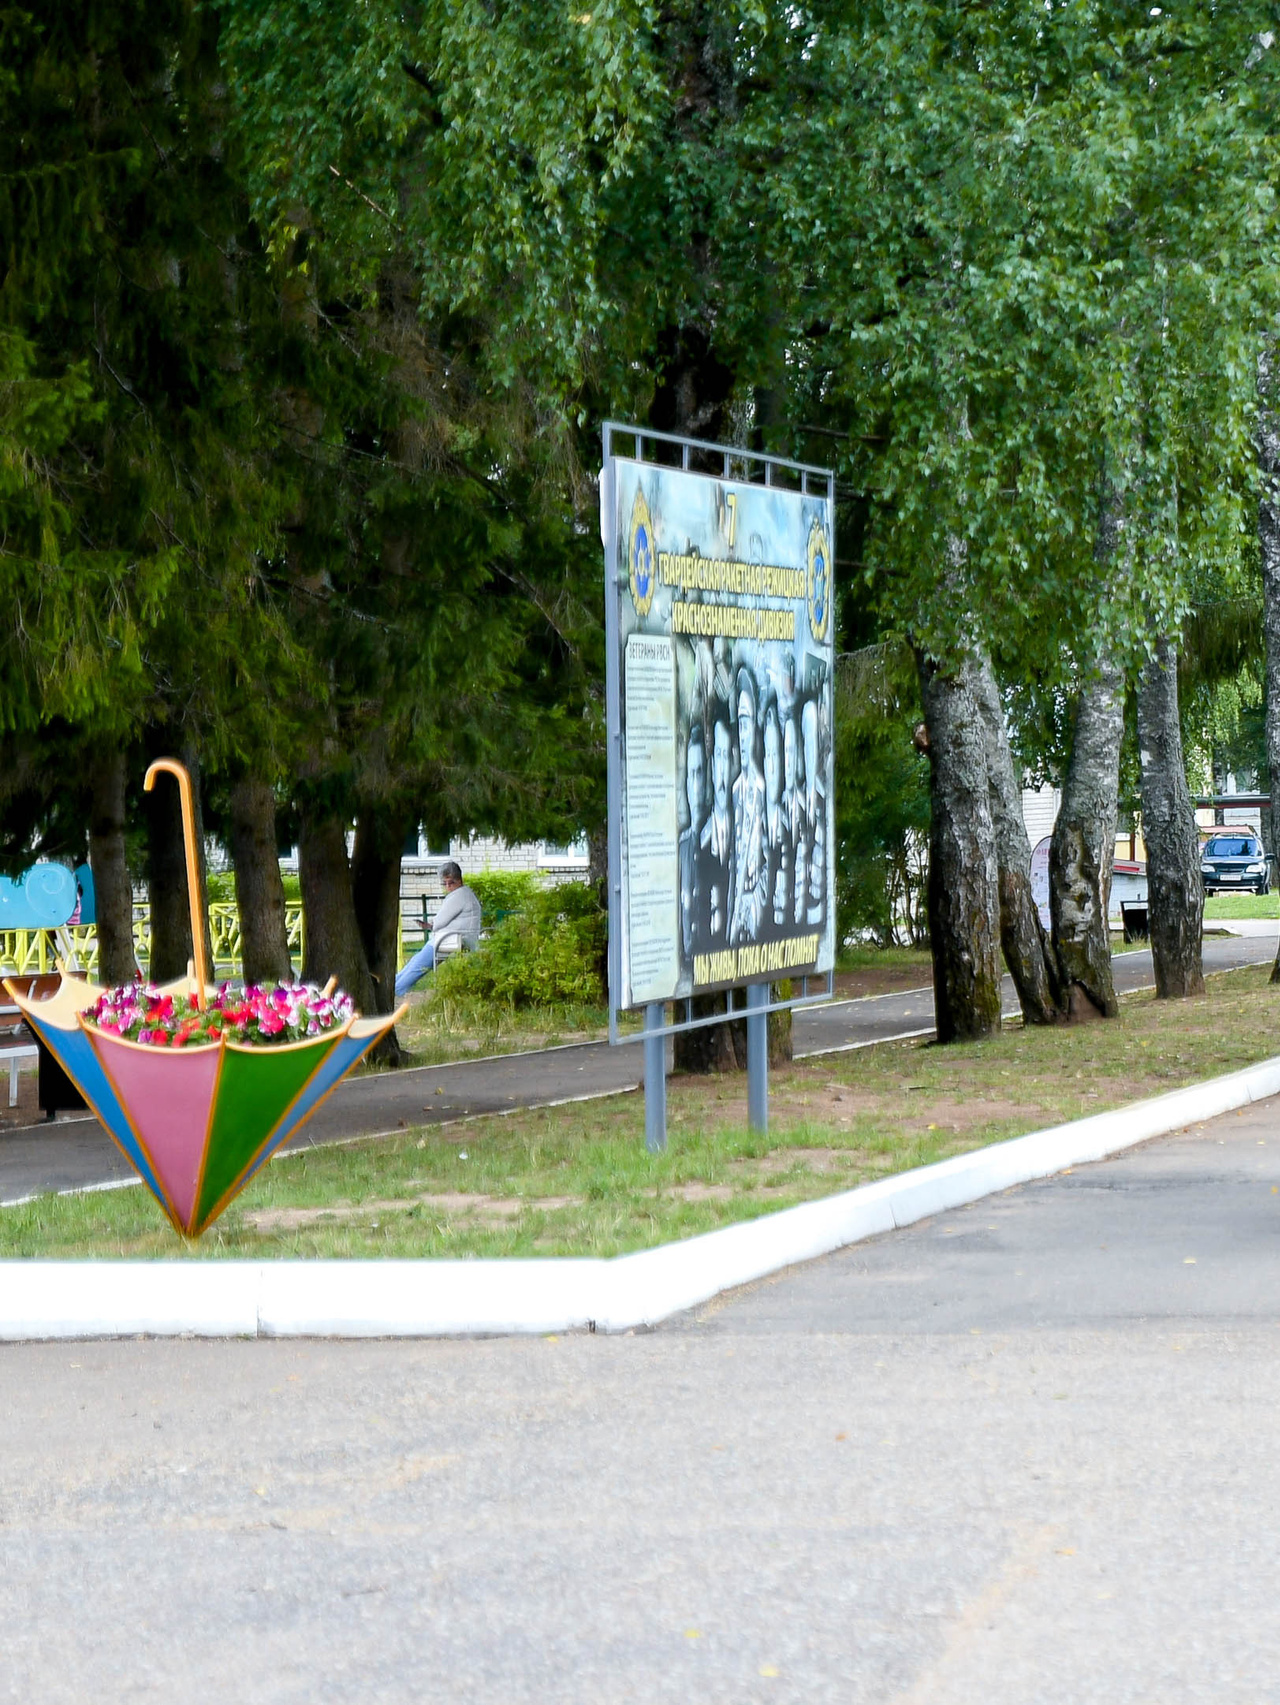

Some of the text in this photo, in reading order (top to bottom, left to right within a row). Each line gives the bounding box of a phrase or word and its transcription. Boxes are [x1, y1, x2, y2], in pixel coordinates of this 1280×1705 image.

[726, 493, 737, 548] 7
[658, 553, 805, 601] ГВАРДЕЙСКАЯ РАКЕТНАЯ РЕЖИЦКАЯ
[672, 601, 795, 643] КРАСНОЗНАМЕННАЯ ДИВИЗИЯ
[629, 641, 656, 660] ВЕТЕРАНЫ
[693, 953, 710, 986] МЫ
[710, 949, 737, 982] ЖИВЫ,
[737, 944, 760, 977] ПОКА
[760, 943, 768, 973] О
[768, 940, 784, 971] НАС
[784, 934, 819, 967] ПОМНЯТ
